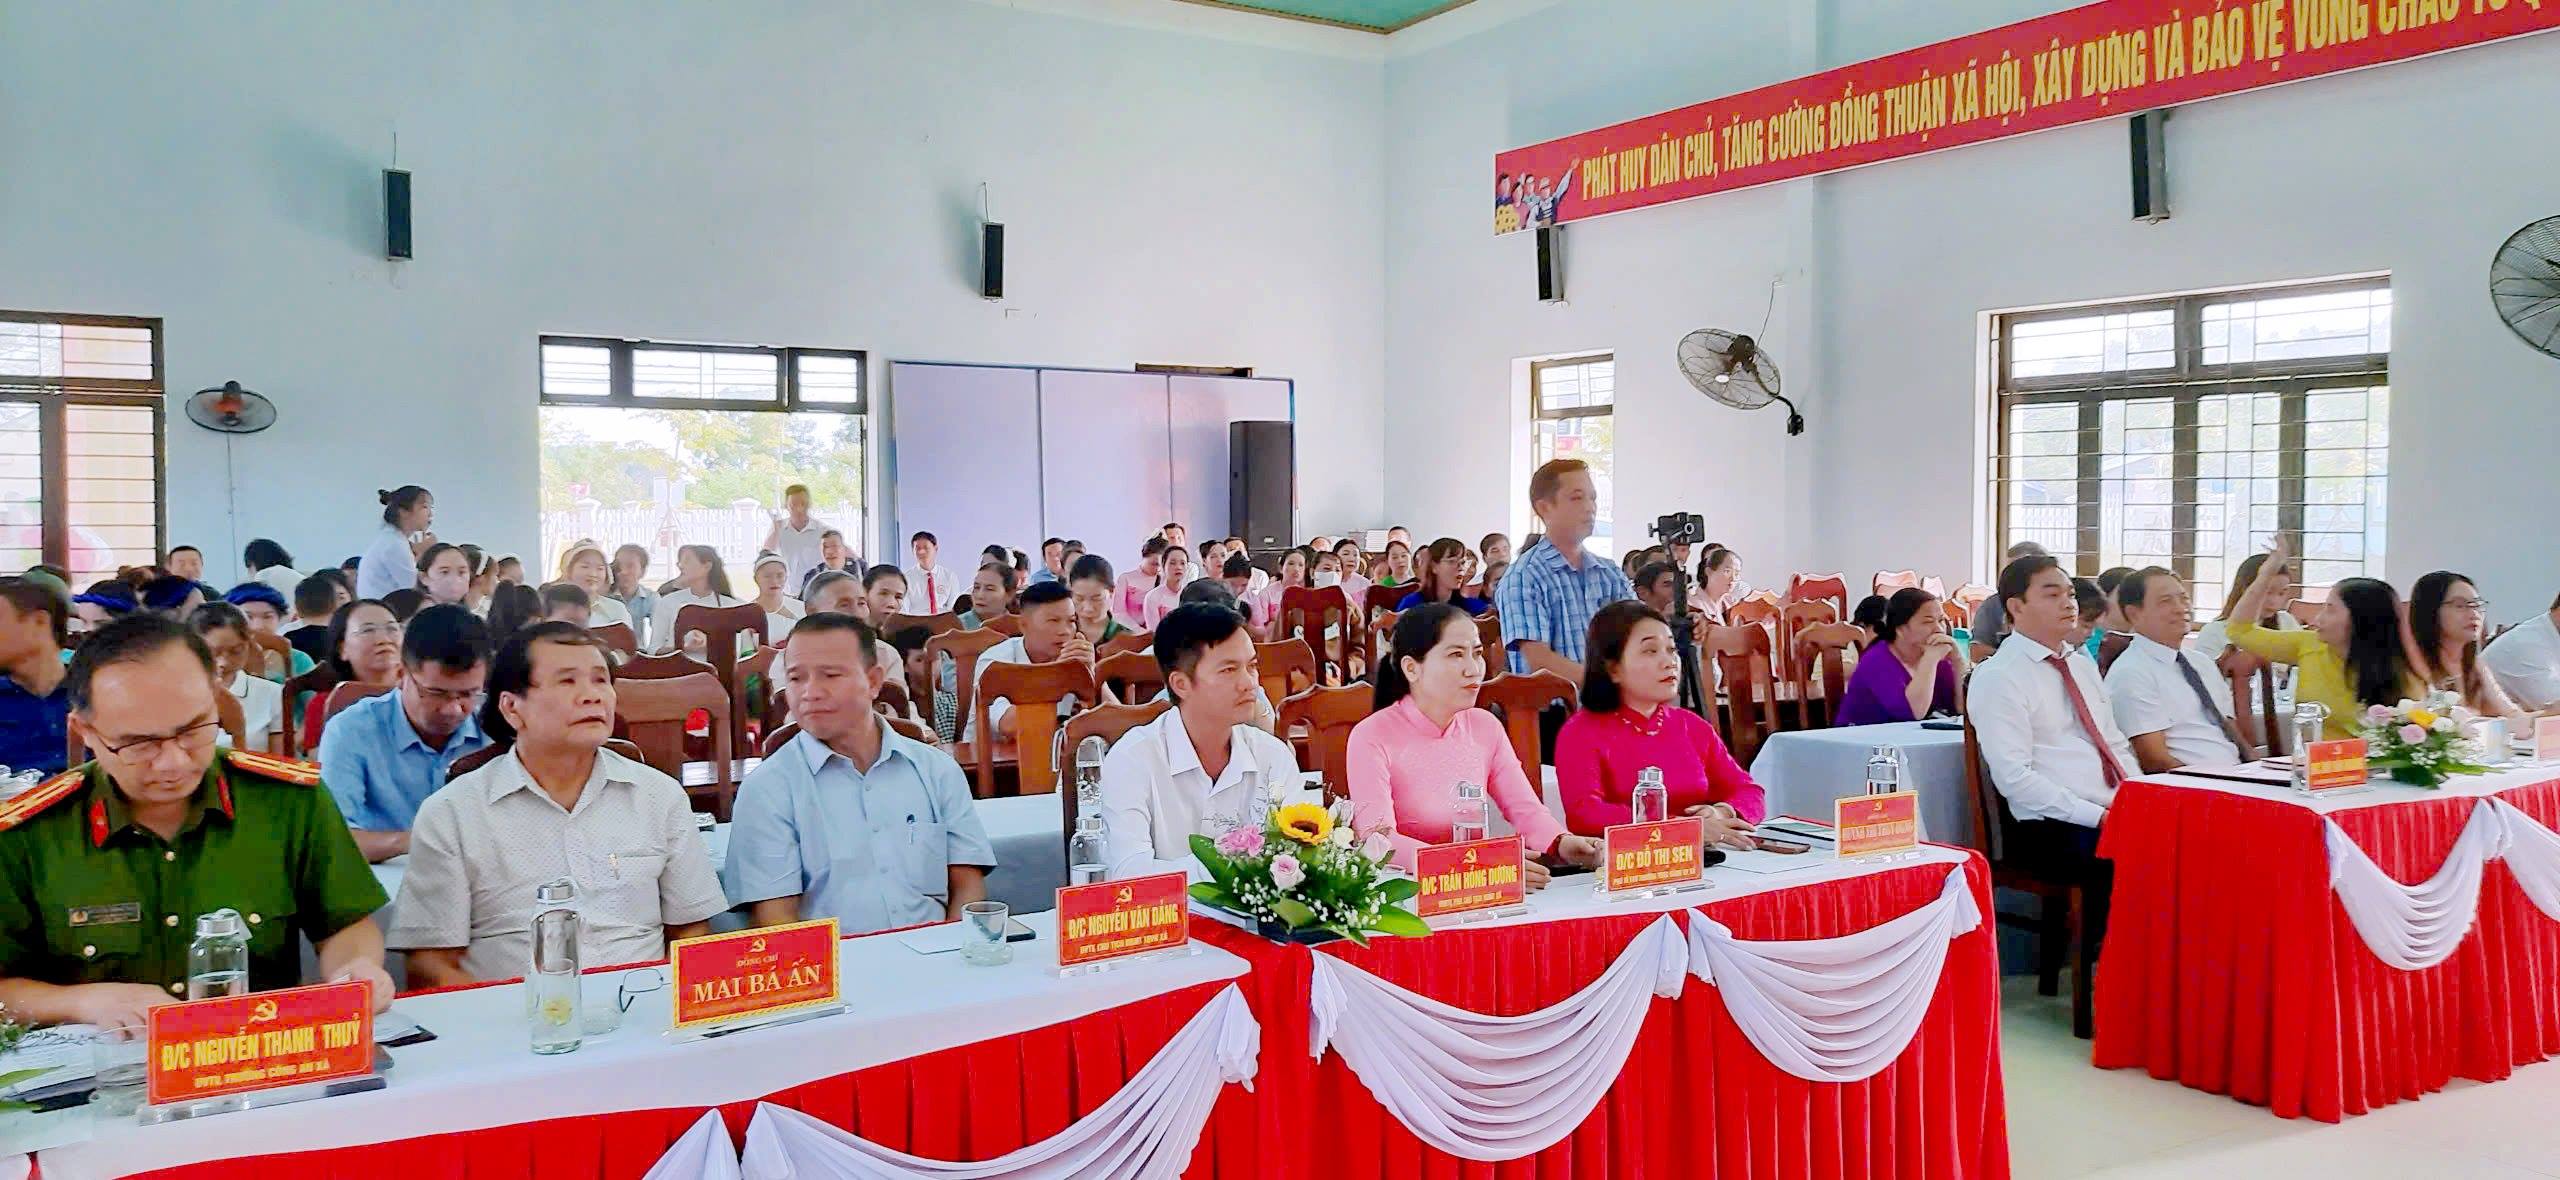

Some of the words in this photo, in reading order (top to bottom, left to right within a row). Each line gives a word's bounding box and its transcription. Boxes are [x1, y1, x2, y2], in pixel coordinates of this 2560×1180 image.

[1583, 147, 1617, 200] PHÁT
[1620, 146, 1647, 193] HUY
[1650, 132, 1680, 187] DÂN
[1684, 115, 1718, 180] CHỦ,
[1722, 113, 1763, 172] TĂNG
[1768, 99, 1825, 162] CƯỜNG
[1829, 82, 1879, 150] ĐỒNG
[1884, 69, 1947, 142] THUẬN
[1951, 57, 1979, 125] XÃ
[1984, 50, 2026, 126] HỘI,
[2032, 38, 2076, 108] XÂY
[2082, 30, 2146, 106] DỰNG
[2153, 8, 2185, 82] VÀ
[2192, 0, 2244, 74] BẢO
[1654, 848, 1670, 868] THỊ
[1672, 845, 1693, 863] SEN
[1438, 867, 1462, 892] TRẦN
[1088, 905, 1128, 936] NGUYỄN
[1130, 905, 1150, 929] VĂN
[693, 976, 743, 1003] MAI
[747, 965, 784, 994] BÁ
[787, 958, 822, 988] ẤN
[194, 1027, 259, 1067] NGUYỄN
[263, 1027, 314, 1057] THANH
